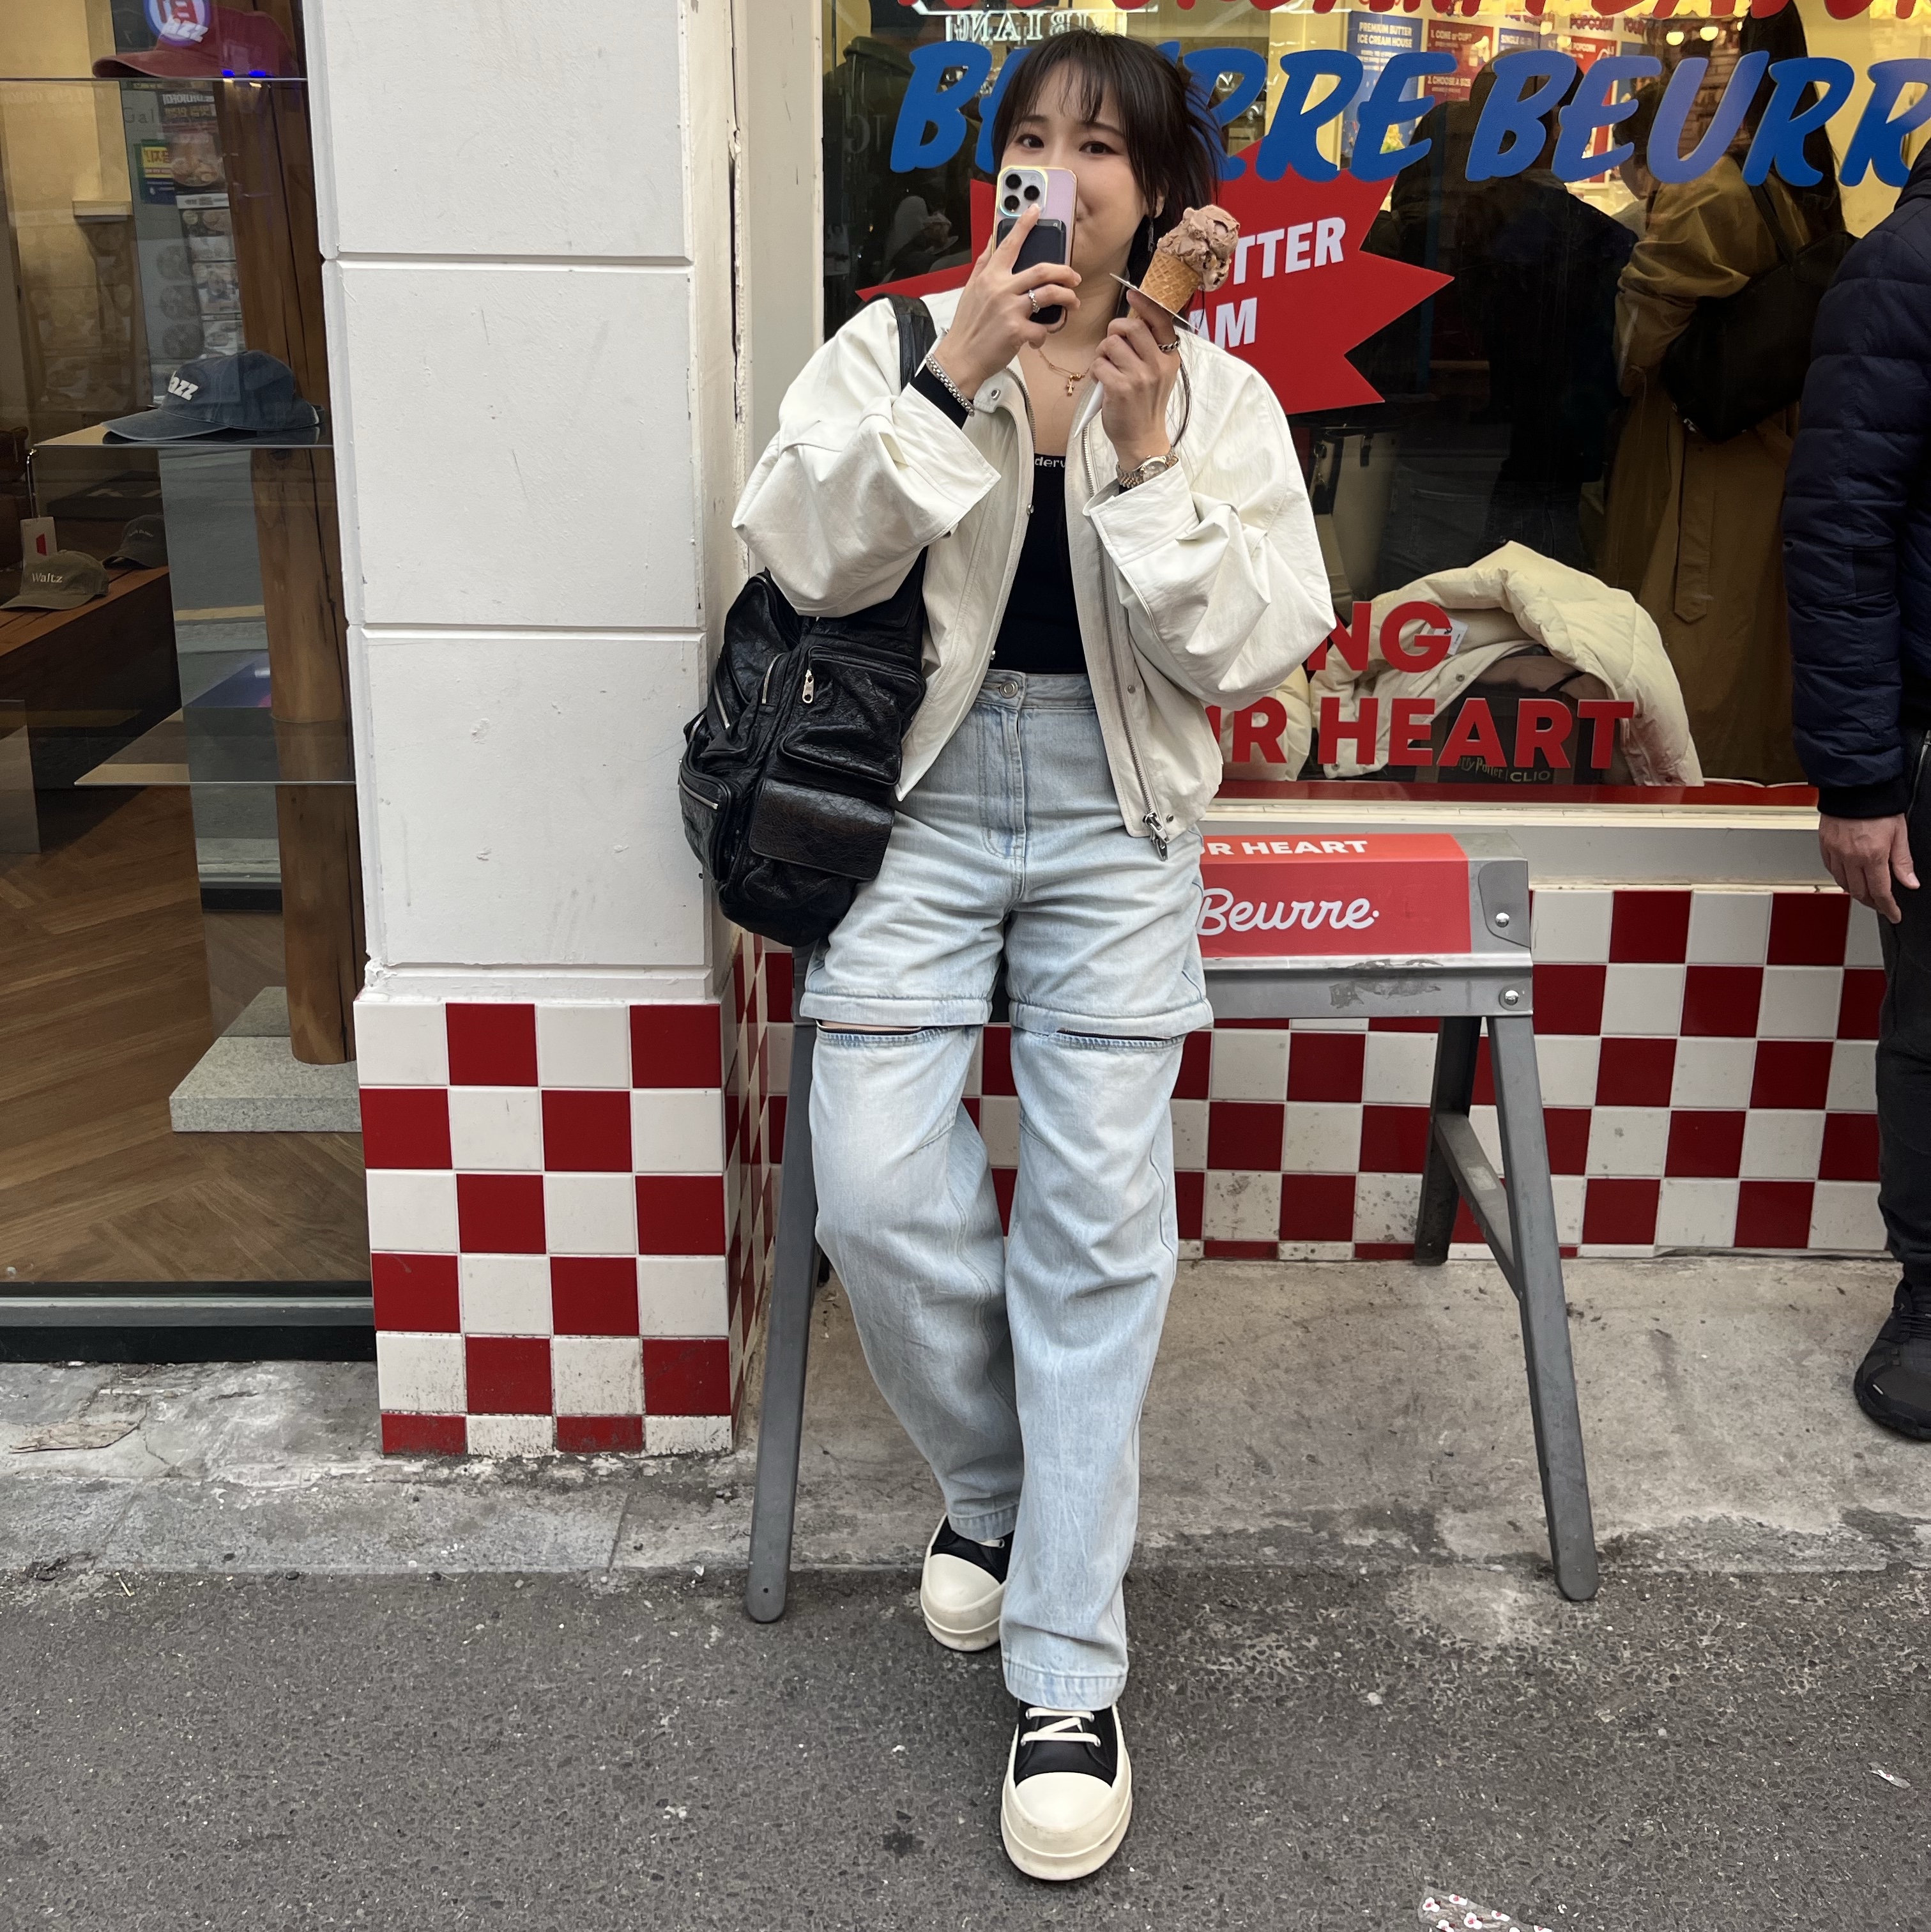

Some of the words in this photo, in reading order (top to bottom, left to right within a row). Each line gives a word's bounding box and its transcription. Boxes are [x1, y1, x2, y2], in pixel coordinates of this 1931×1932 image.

[168, 371, 199, 401] azz
[32, 572, 63, 583] Waltz
[1318, 697, 1635, 769] HEART
[1509, 770, 1551, 783] CLIO
[1201, 842, 1235, 855] R
[1240, 840, 1368, 855] HEART
